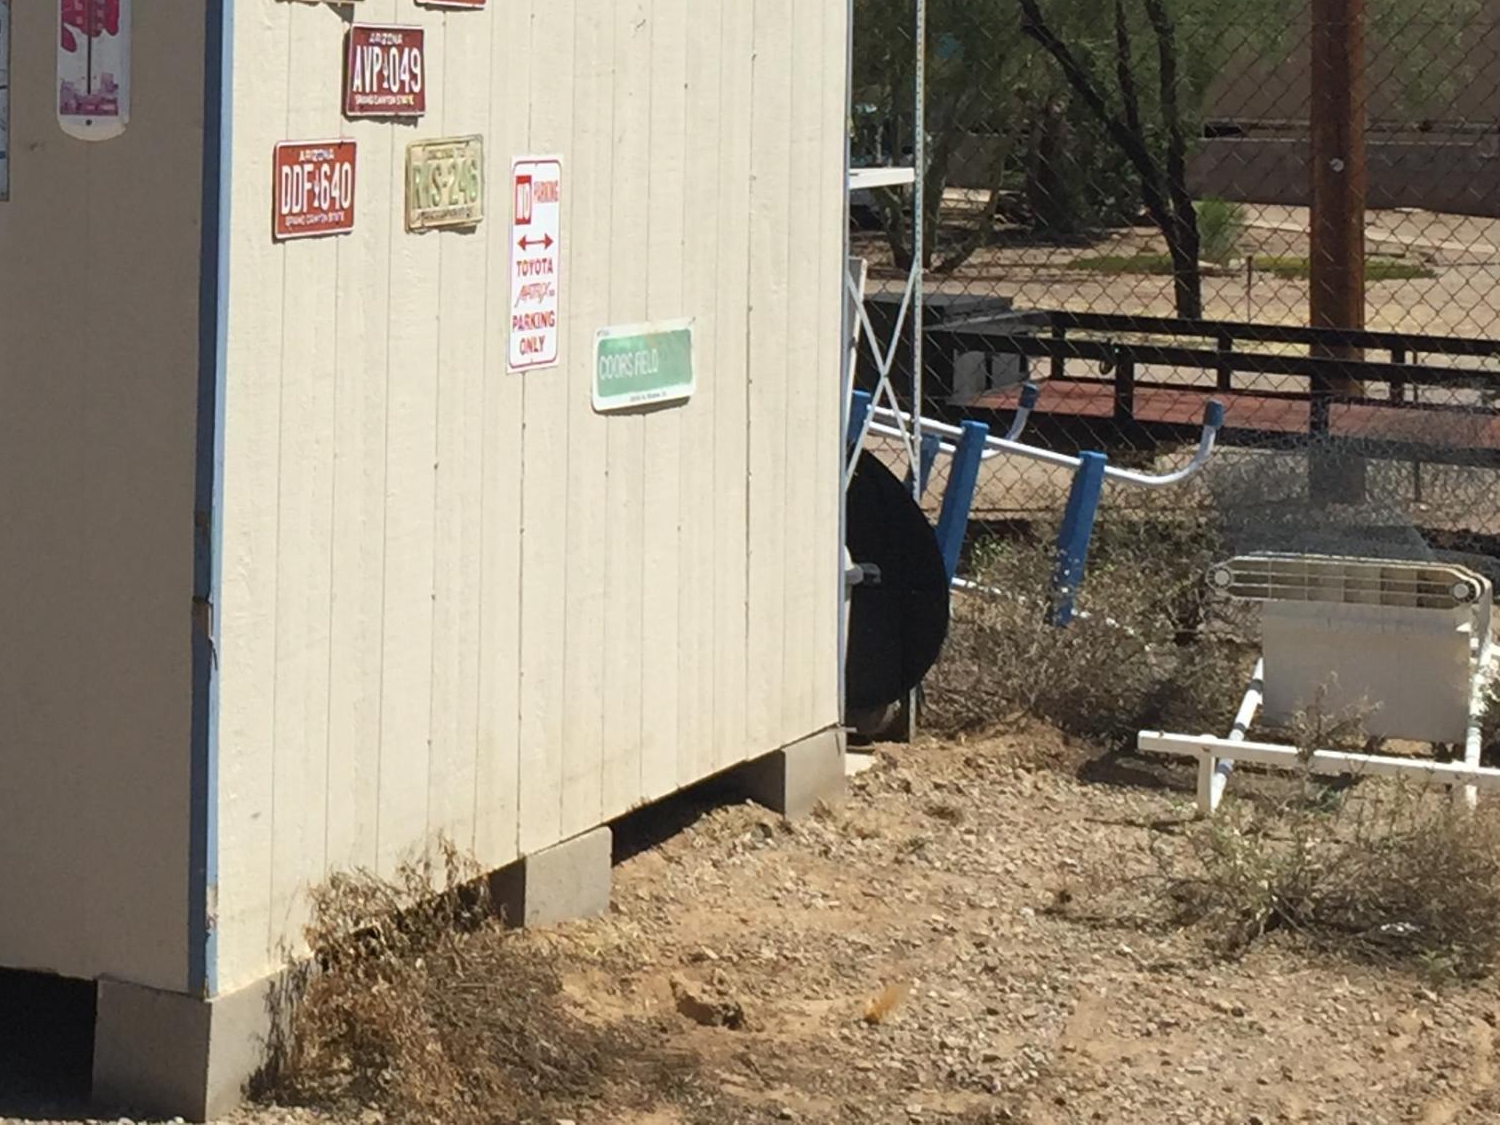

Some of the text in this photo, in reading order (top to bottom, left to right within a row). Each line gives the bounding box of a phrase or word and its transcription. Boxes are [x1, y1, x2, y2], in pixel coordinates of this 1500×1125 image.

[369, 32, 404, 45] ARIZONA
[352, 45, 422, 93] AVP 049
[299, 148, 335, 162] ARIZONA
[281, 161, 352, 215] DDF 640
[516, 258, 553, 277] TOYOTA
[512, 310, 555, 331] PARKING
[519, 335, 546, 356] ONLY
[599, 347, 660, 381] COORS FIELD
